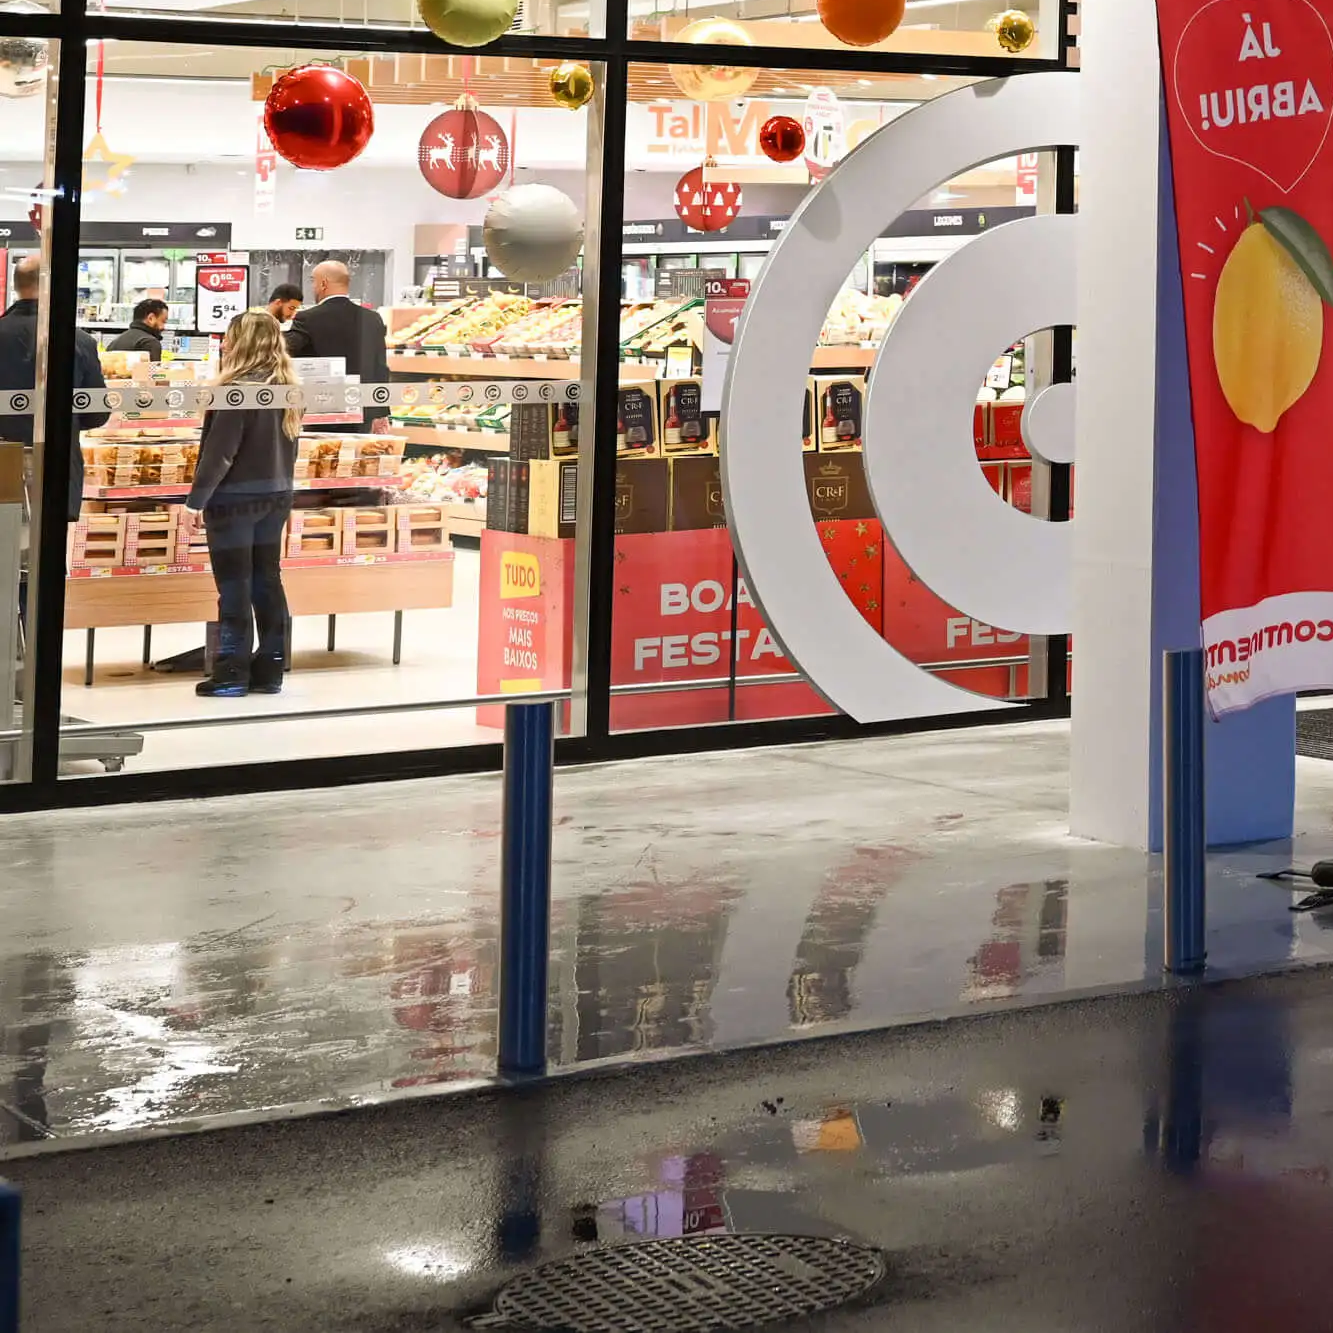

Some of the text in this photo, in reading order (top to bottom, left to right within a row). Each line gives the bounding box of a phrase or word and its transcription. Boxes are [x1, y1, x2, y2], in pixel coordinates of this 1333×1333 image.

[647, 106, 700, 139] Tal
[504, 563, 536, 590] TUDO
[660, 577, 758, 616] BOA
[502, 606, 539, 625] AOS PREÇOS
[509, 626, 533, 649] MAIS
[633, 627, 785, 671] FESTA
[503, 647, 538, 671] BAIXOS
